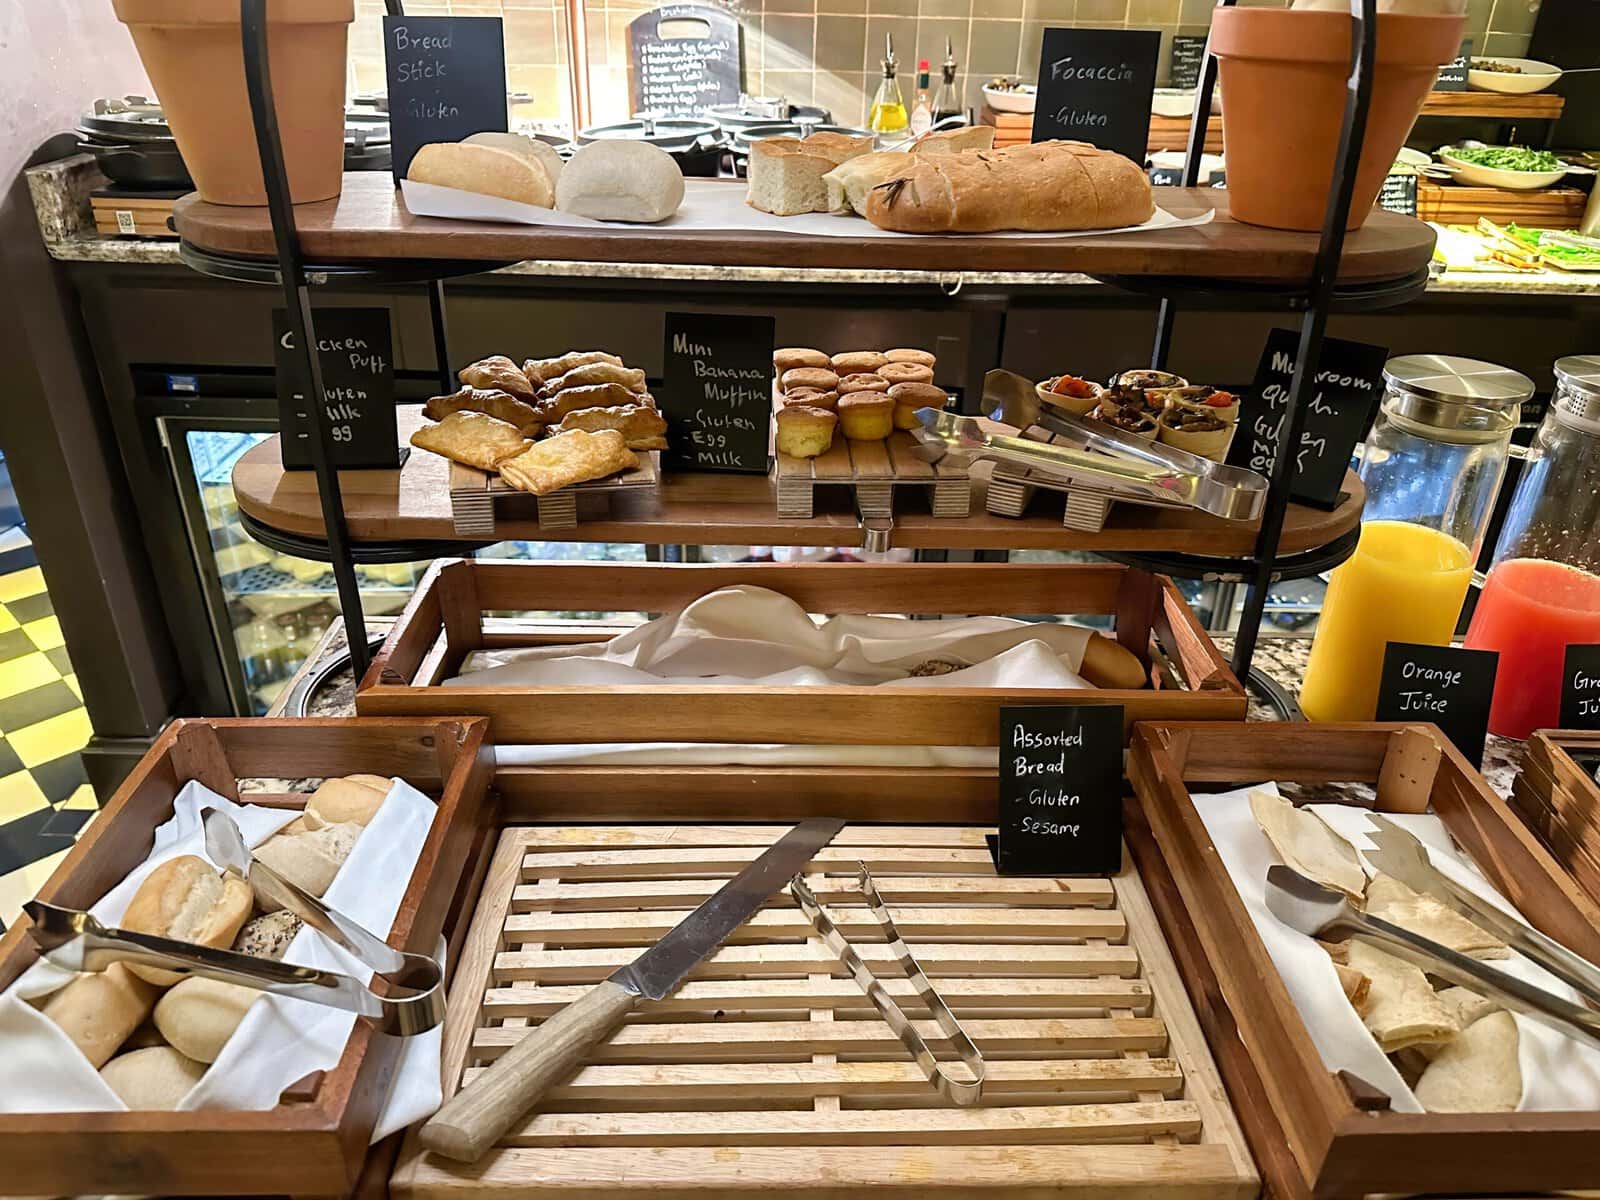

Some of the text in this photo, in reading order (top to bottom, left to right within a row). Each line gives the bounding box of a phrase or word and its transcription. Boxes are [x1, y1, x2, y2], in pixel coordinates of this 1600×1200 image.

[393, 26, 454, 51] Bread
[397, 60, 447, 82] Stick
[1050, 57, 1134, 81] Focaccia
[280, 331, 368, 352] Ccken
[673, 332, 713, 357] Mini
[349, 353, 386, 375] Puff
[693, 360, 765, 379] Banana
[1271, 351, 1373, 391] Muroom
[704, 382, 767, 408] Muffin
[332, 425, 352, 442] gg
[1402, 661, 1463, 689] Orange
[1399, 691, 1448, 713] Juice
[1013, 724, 1083, 748] Assorted
[1013, 752, 1065, 776] Bread
